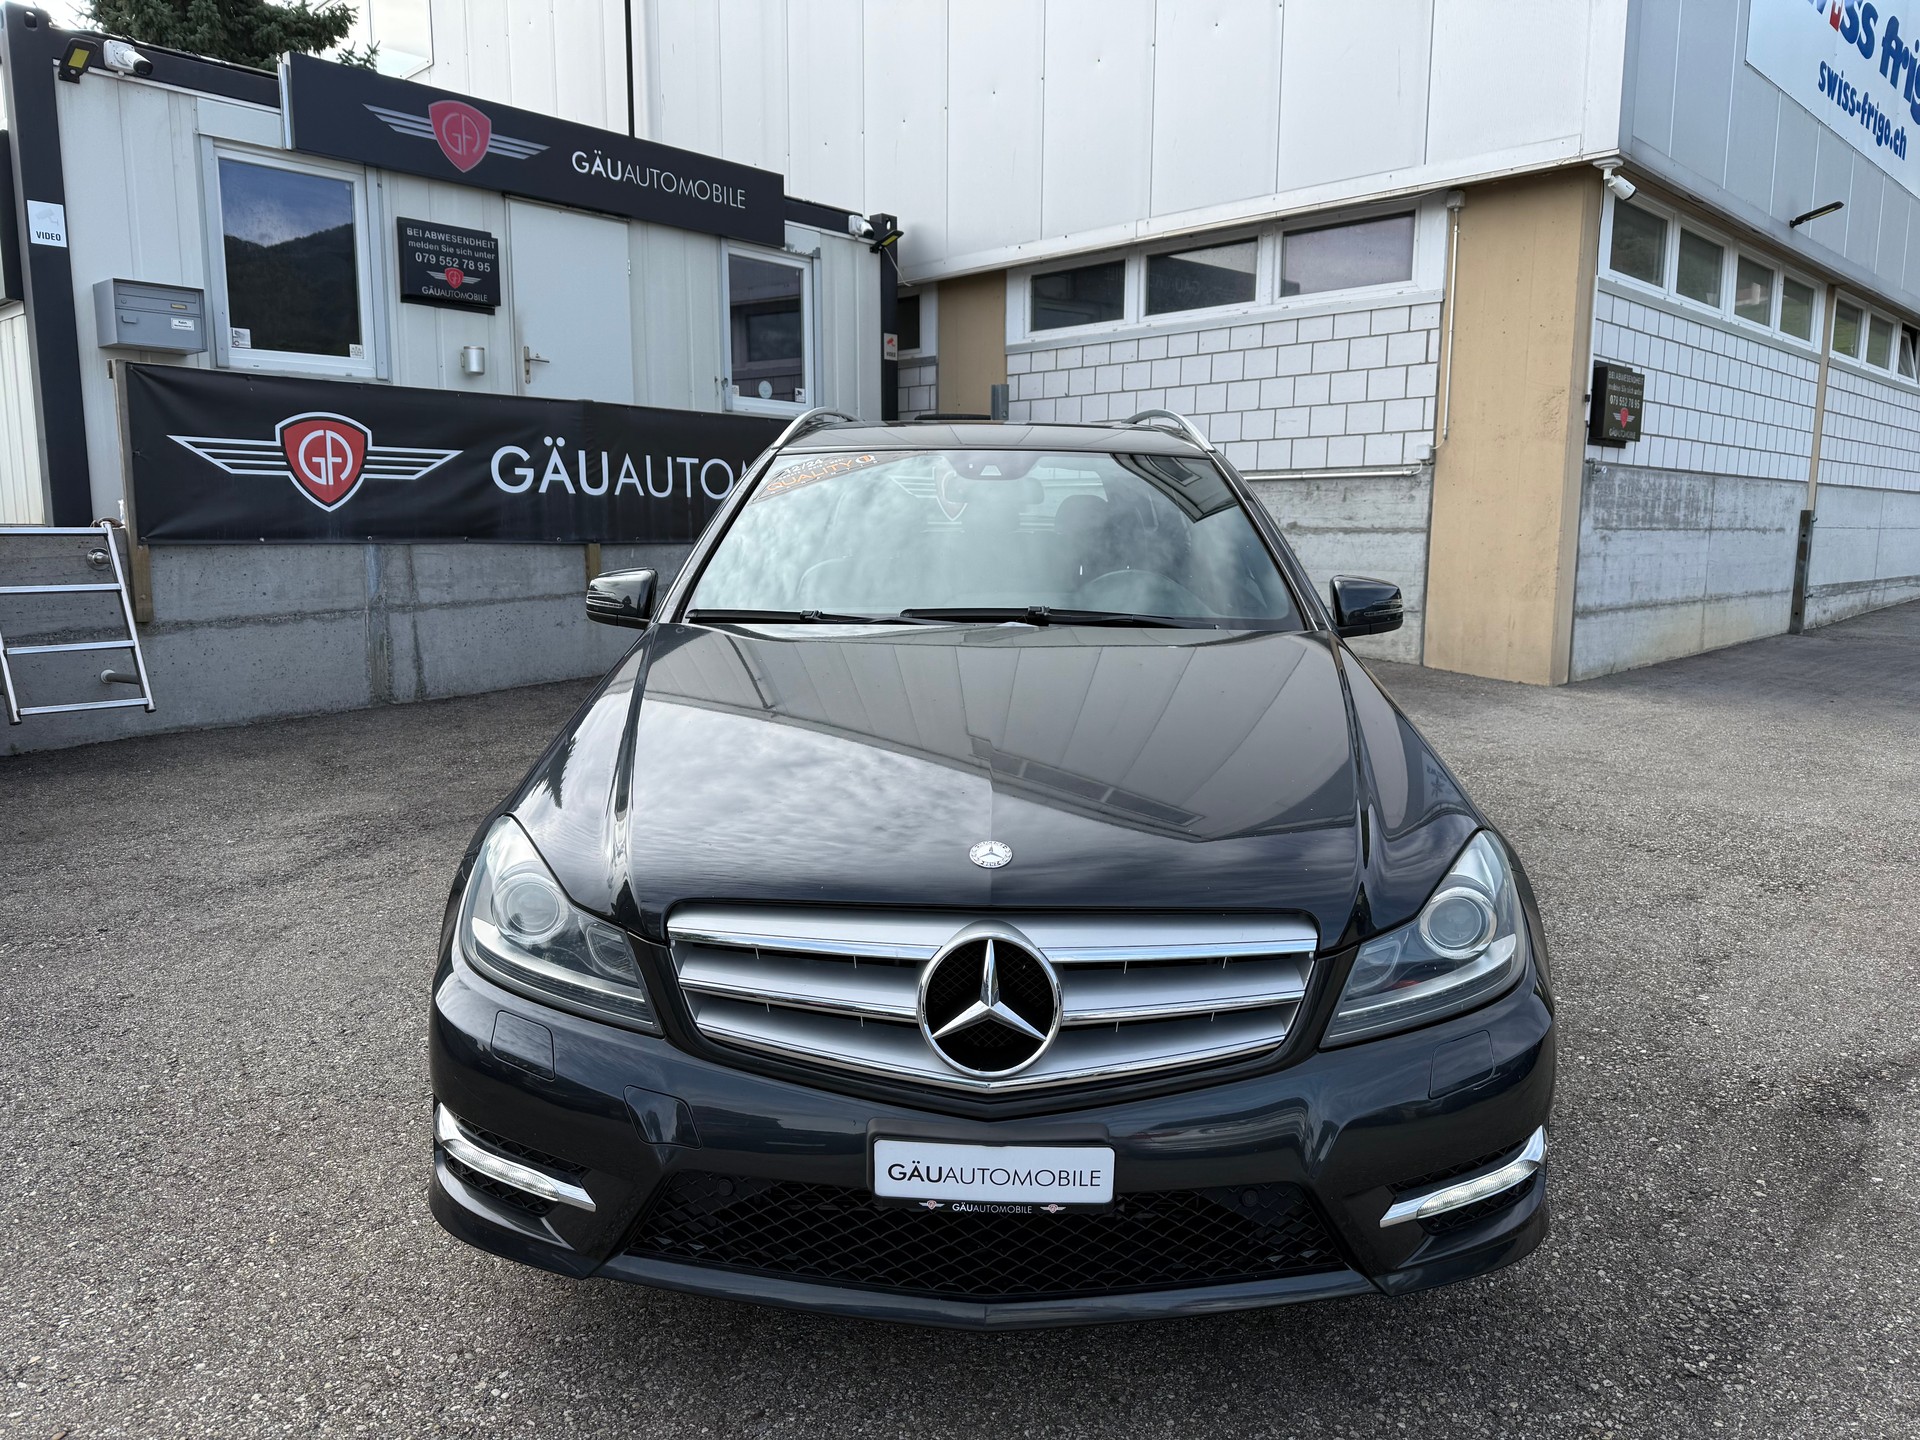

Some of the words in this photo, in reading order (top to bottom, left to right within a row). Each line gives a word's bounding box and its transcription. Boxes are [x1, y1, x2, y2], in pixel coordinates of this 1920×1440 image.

[1818, 60, 1907, 161] swiss-frigo.ch
[571, 149, 746, 209] GÄUAUTOMOBILE
[35, 230, 62, 242] VIDEO
[406, 227, 422, 237] BEI
[424, 230, 496, 249] ABWESENDHEIT
[408, 240, 440, 250] melden
[441, 244, 455, 254] Sie
[456, 246, 473, 256] sich
[474, 251, 496, 260] unter
[415, 252, 437, 264] 079
[439, 256, 460, 268] 552
[462, 259, 475, 270] 78
[477, 262, 491, 273] 95
[421, 285, 488, 302] GÄUAUTOMOBILE
[490, 436, 747, 500] GÄUAUTO
[767, 459, 852, 491] QUALITY
[888, 1160, 1101, 1188] GÄUAUTOMOBILE
[952, 1201, 1033, 1214] GÄUAUTOMOBILE
